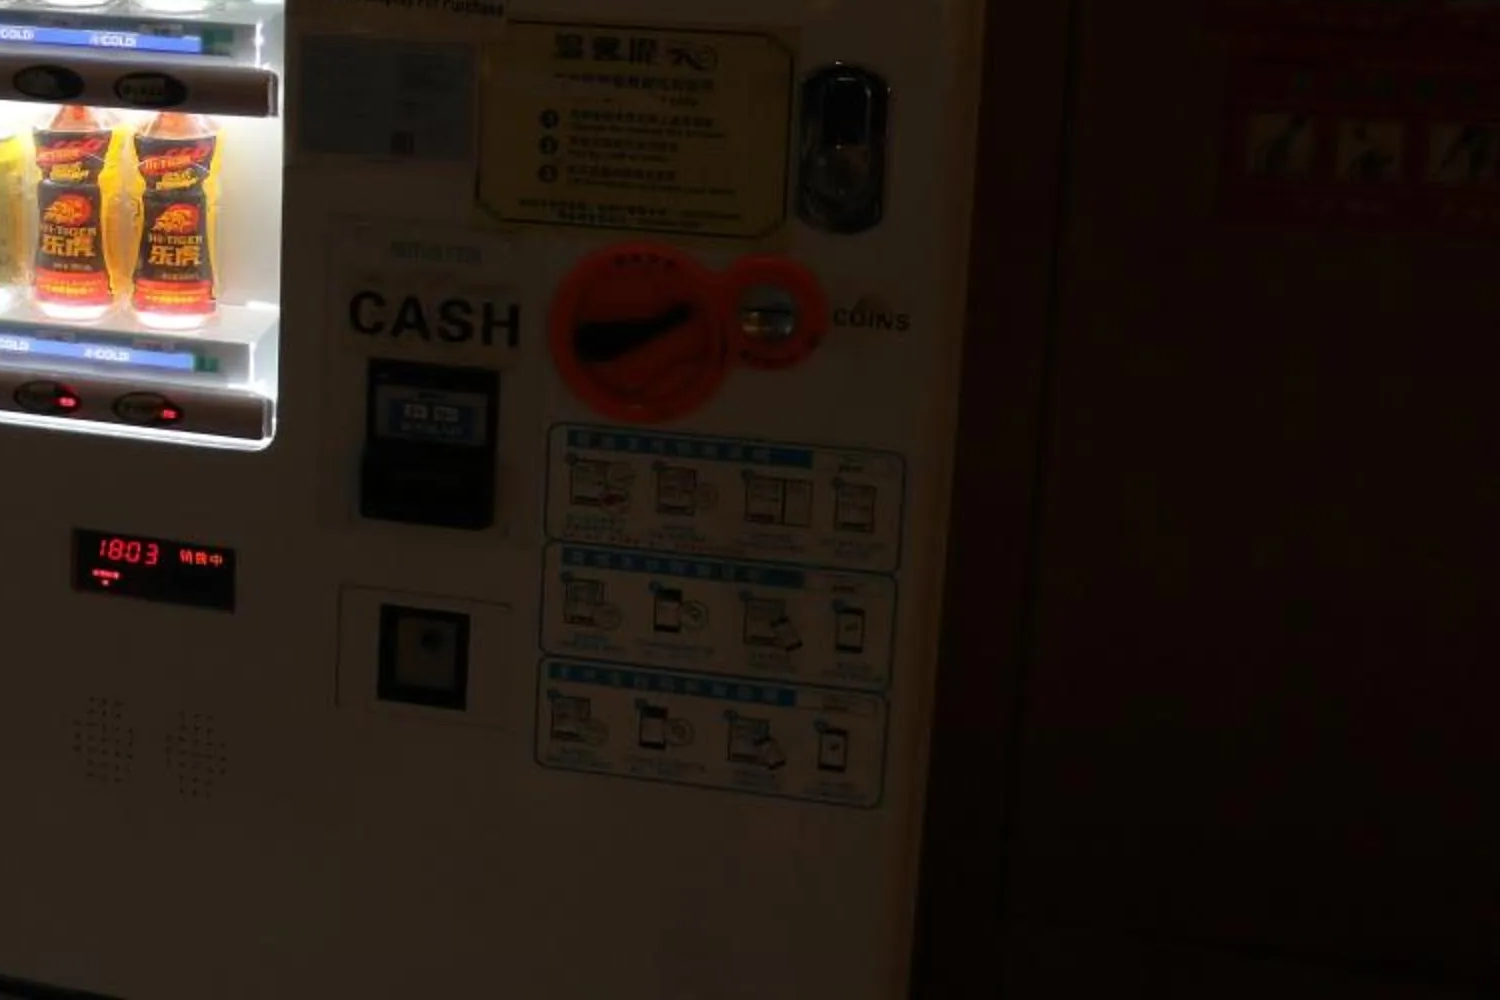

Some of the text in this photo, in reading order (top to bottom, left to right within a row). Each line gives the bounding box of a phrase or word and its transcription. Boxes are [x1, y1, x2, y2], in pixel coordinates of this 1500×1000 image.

[350, 290, 520, 347] CASH
[833, 307, 911, 331] COINS
[99, 539, 160, 566] 1803
